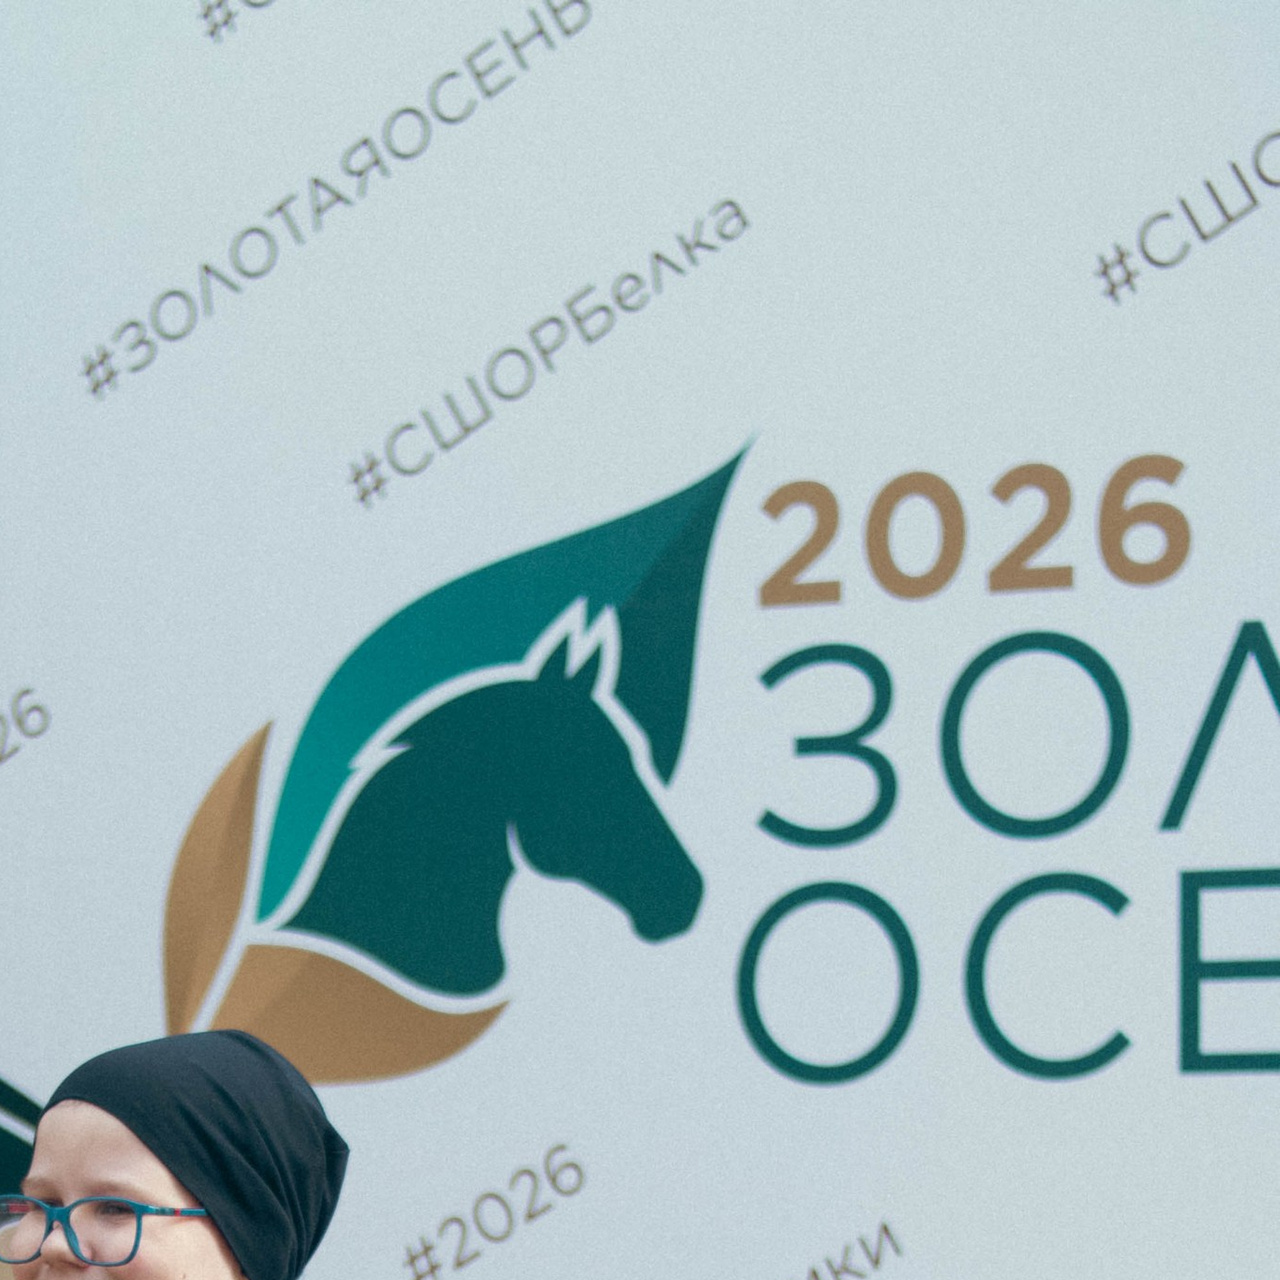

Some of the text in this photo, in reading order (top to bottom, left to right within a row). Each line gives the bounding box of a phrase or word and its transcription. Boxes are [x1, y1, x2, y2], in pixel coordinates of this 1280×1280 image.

[80, 0, 593, 398] #ЗОЛОТАЯОСЕНЬ
[348, 198, 752, 508] #СШОРБелка
[759, 453, 1192, 609] 2026
[755, 619, 1280, 851] ЗОЛ
[734, 869, 1280, 1088] ОСЕ
